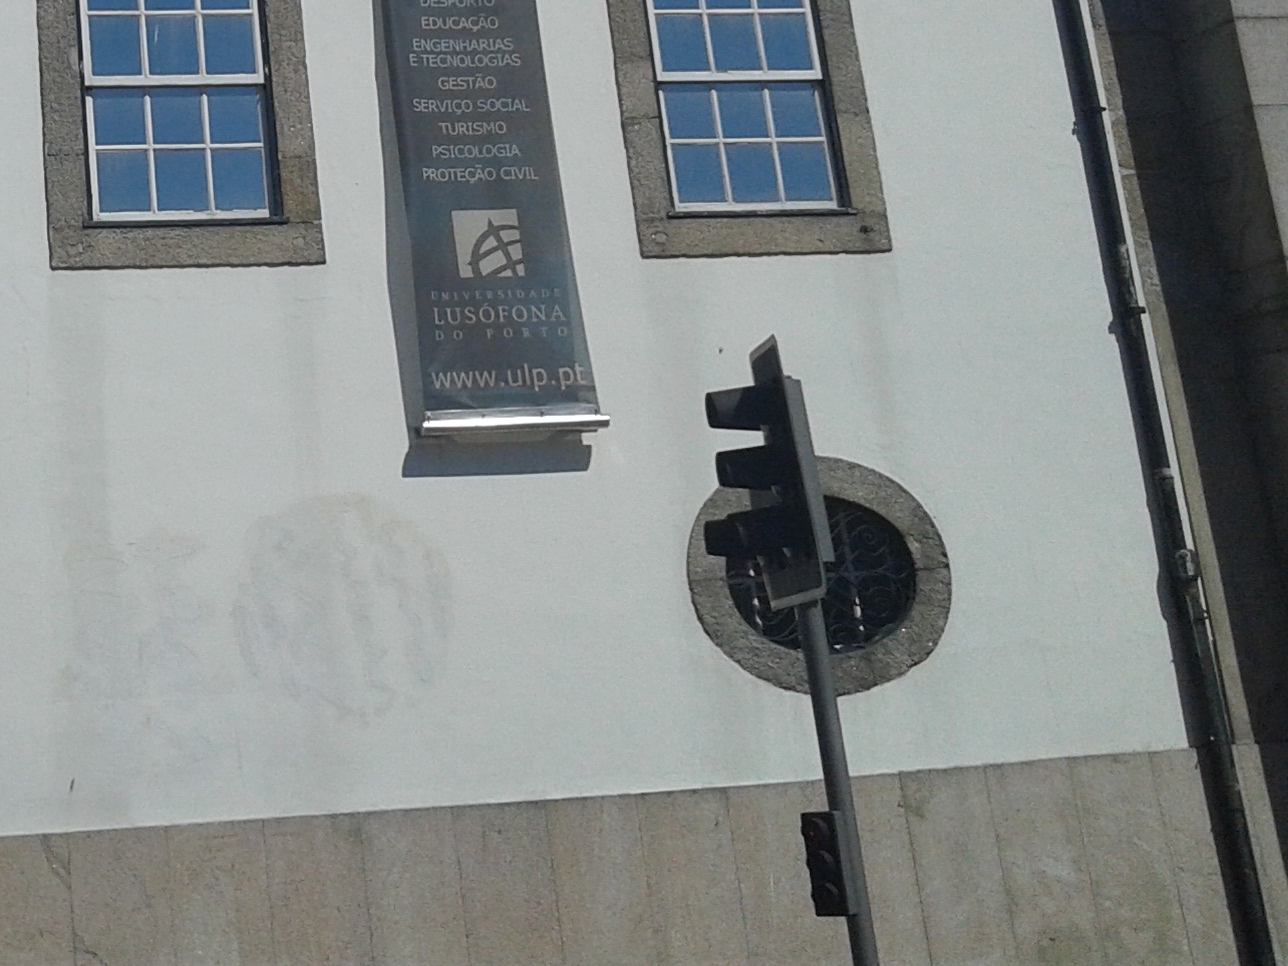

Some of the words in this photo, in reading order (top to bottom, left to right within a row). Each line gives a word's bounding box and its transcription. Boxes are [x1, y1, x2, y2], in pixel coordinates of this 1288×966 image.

[421, 14, 499, 32] EDUCAÇÃO
[412, 38, 514, 52] ENGENHARIAS
[409, 54, 418, 66] E
[420, 53, 521, 67] TECNOLOGIAS
[438, 74, 496, 89] GESTÃO
[413, 99, 472, 115] SERVIÇO
[477, 98, 530, 112] SOCIAL
[438, 121, 506, 135] TURISMO
[432, 144, 521, 158] PSICOLOGIA
[422, 165, 496, 183] PROTEÇÃO
[500, 167, 539, 180] CIVIL
[431, 288, 561, 300] UNIVERSIDADE
[432, 303, 567, 325] LUSÓFONA
[435, 330, 463, 341] DO
[487, 327, 567, 339] PORTO
[431, 363, 587, 392] www.ulp.pt
